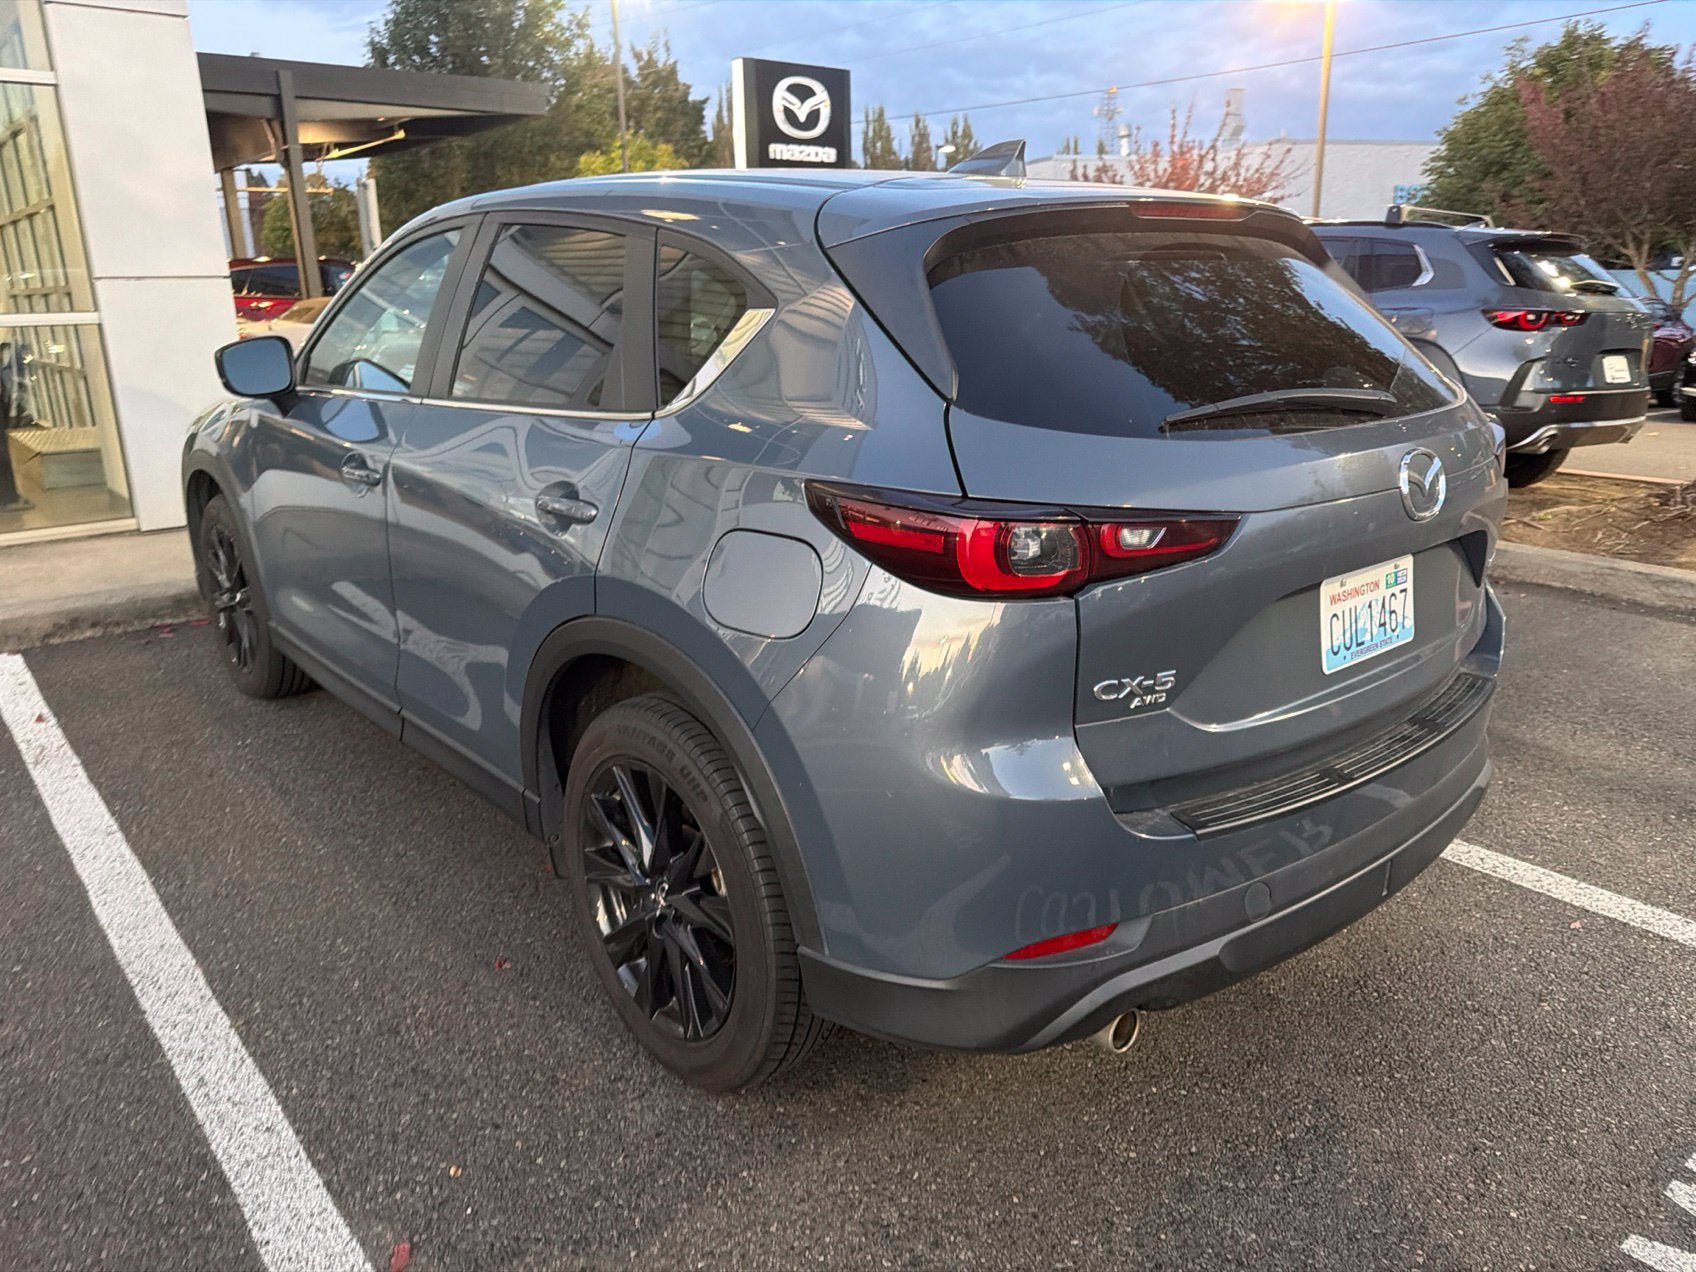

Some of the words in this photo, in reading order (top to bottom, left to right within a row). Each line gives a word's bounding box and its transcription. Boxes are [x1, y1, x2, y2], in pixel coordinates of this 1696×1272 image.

[768, 143, 837, 163] mazda
[1329, 579, 1381, 606] WASHINGTON
[1330, 588, 1408, 656] CUL1467
[1350, 642, 1379, 659] EVERGREEN
[1093, 669, 1177, 700] CX-5
[1129, 691, 1167, 709] AWD
